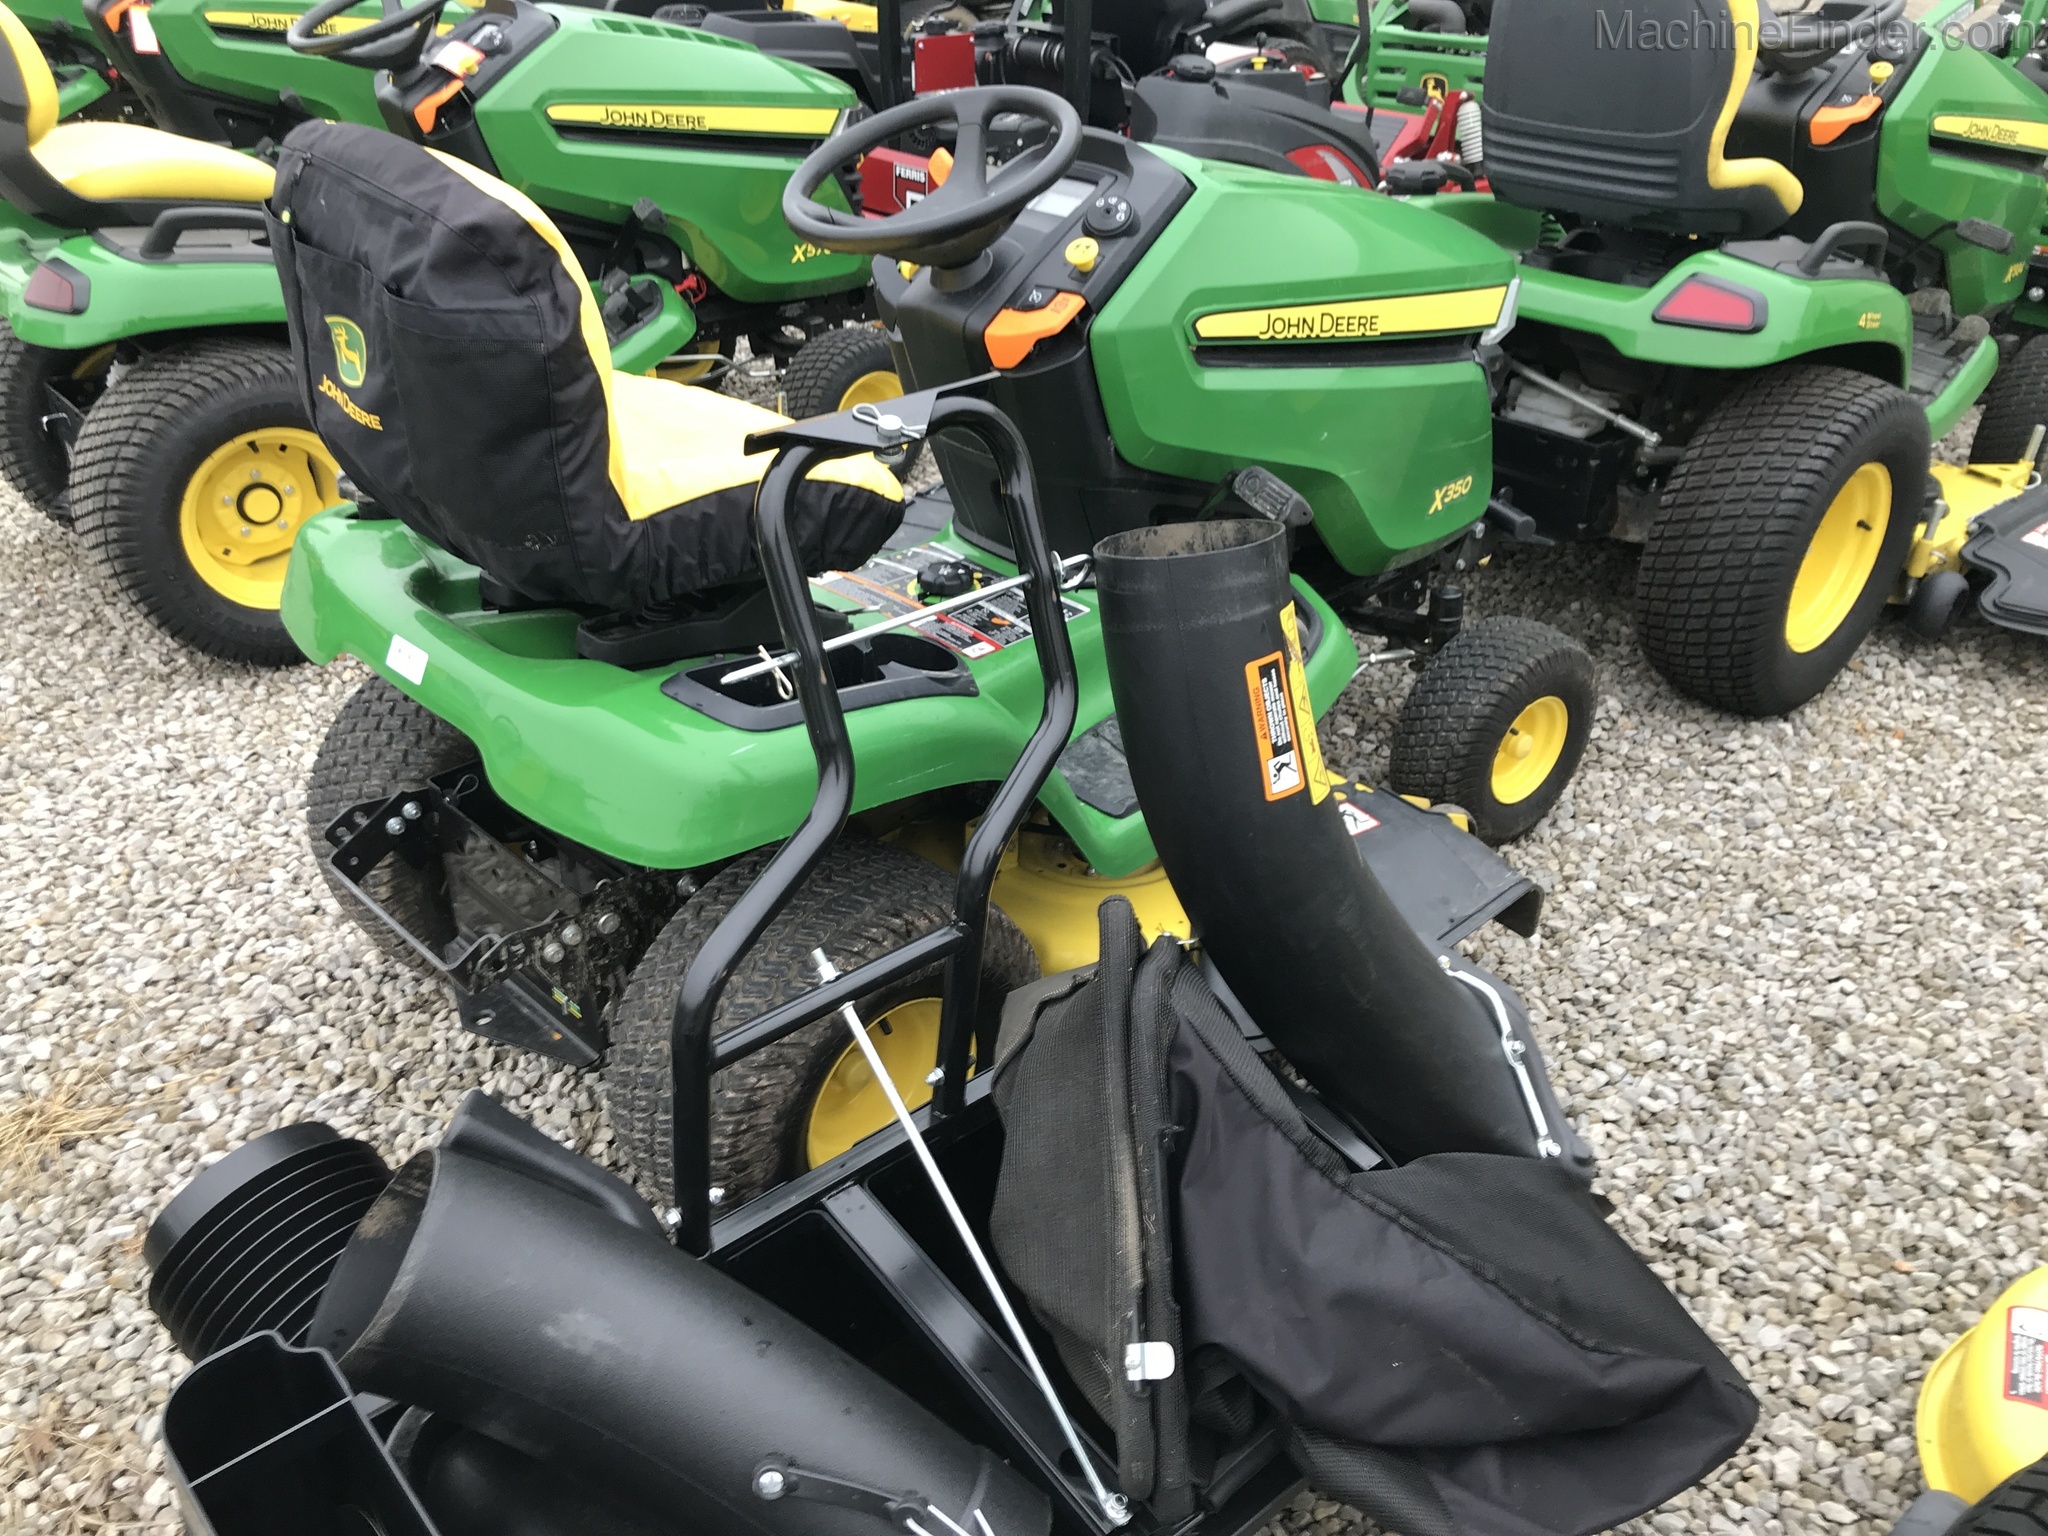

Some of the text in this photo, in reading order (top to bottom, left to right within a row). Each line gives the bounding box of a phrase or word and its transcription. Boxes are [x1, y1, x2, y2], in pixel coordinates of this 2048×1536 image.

[249, 13, 288, 29] JOHN
[601, 106, 707, 130] JOHN DEERE
[1962, 120, 1991, 138] JOHN
[895, 165, 926, 183] FERRIS
[1259, 312, 1380, 336] JOHN DEERE
[318, 374, 384, 431] JOHN DEERE
[1428, 474, 1473, 515] X350
[1261, 677, 1272, 711] OBJECTS
[1252, 686, 1268, 732] WARNING
[1267, 711, 1278, 745] THROWN
